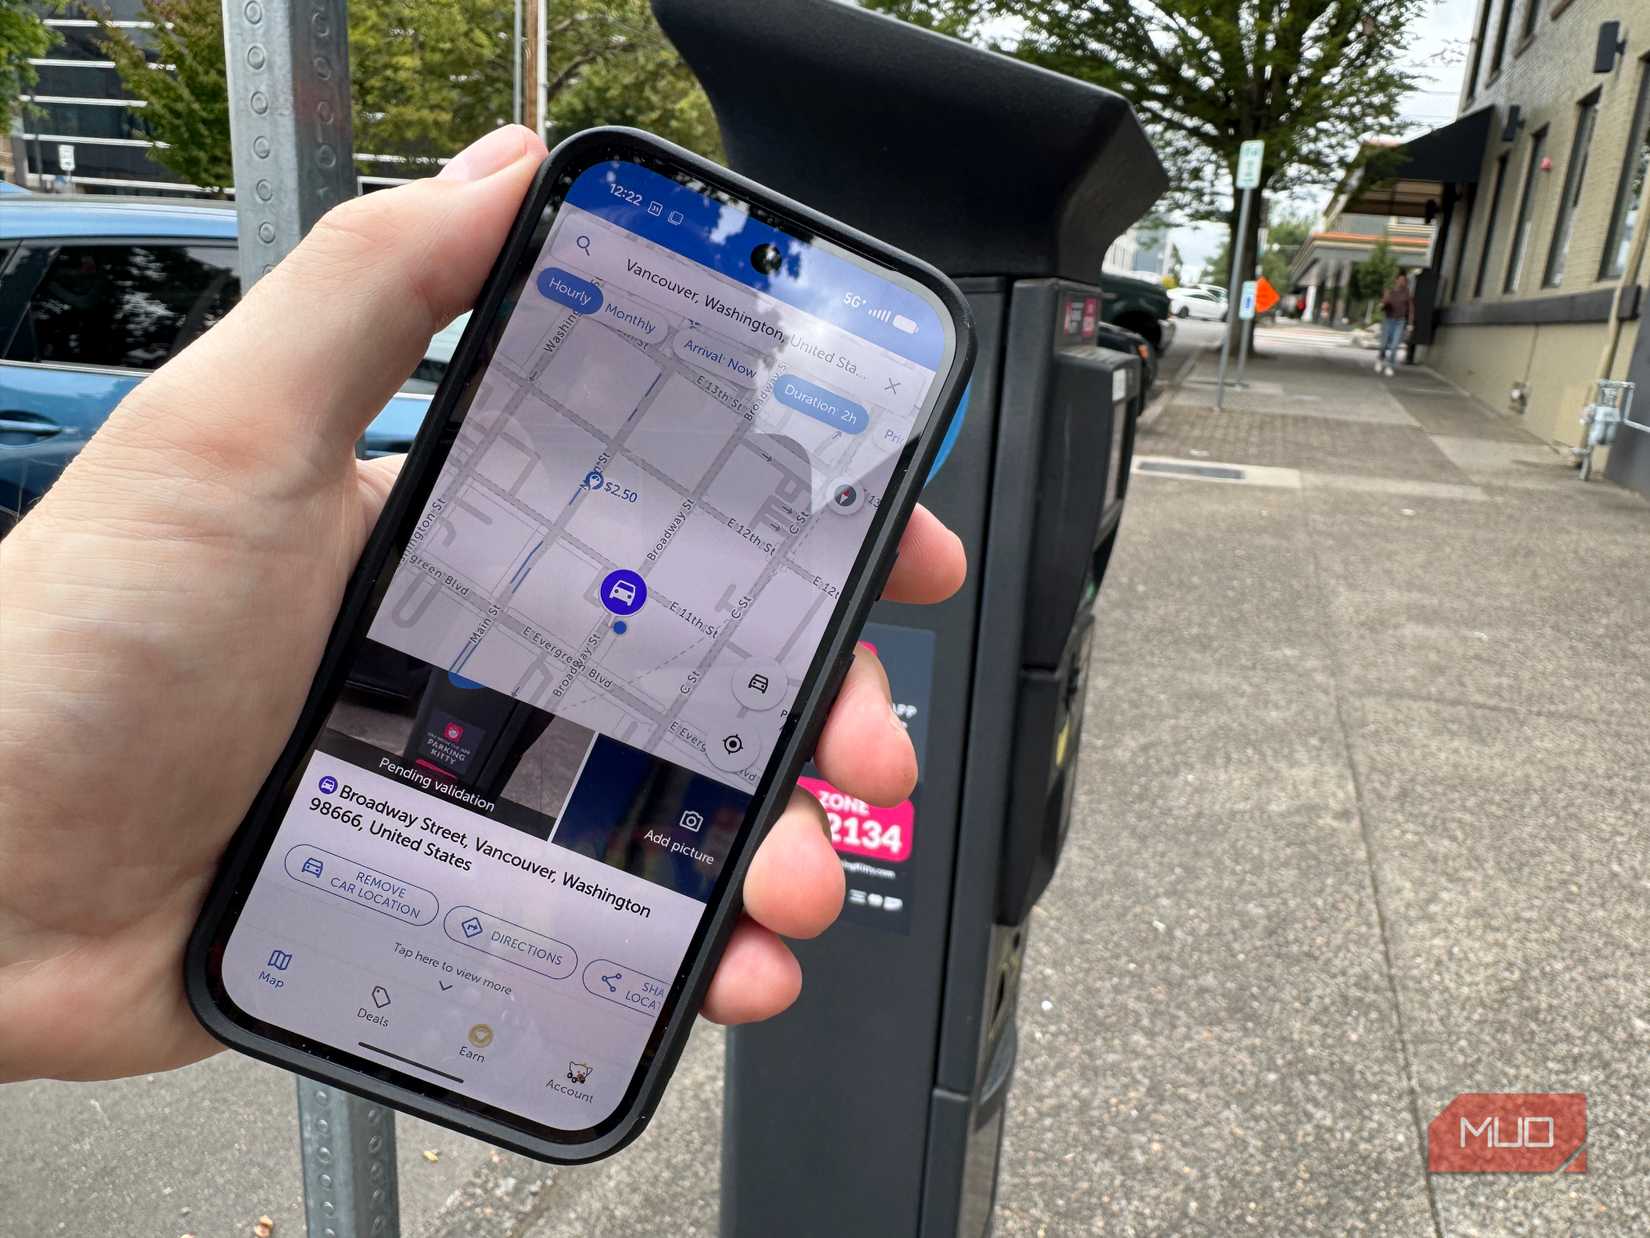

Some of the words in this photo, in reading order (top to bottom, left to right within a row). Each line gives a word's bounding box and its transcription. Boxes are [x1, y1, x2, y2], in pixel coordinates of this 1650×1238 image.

[609, 183, 643, 206] 12:22
[549, 277, 592, 306] Hourly
[605, 303, 656, 335] Monthly
[626, 259, 700, 304] Vancouver,
[704, 294, 785, 343] Washington,
[790, 333, 835, 363] United
[727, 358, 757, 379] Now
[696, 375, 705, 385] E
[705, 381, 728, 402] 13th
[731, 399, 742, 411] St
[841, 409, 857, 425] 2h
[432, 498, 447, 511] St
[604, 481, 638, 503] $2.50
[647, 511, 686, 561] Broadway
[682, 498, 695, 511] St
[796, 512, 809, 524] St
[727, 518, 737, 528] E
[737, 525, 761, 546] 12th
[764, 543, 776, 556] St
[444, 575, 471, 596] Blvd
[812, 576, 821, 587] E
[669, 602, 679, 612] E
[679, 608, 703, 630] 11th
[705, 625, 718, 639] St
[731, 609, 741, 619] C
[738, 596, 752, 609] St
[470, 617, 492, 644] Main
[488, 604, 501, 616] St
[588, 633, 601, 646] St
[522, 626, 532, 636] E
[532, 633, 586, 673] Evergreen
[588, 669, 613, 689] Blvd
[680, 684, 691, 695] C
[687, 671, 700, 684] St
[670, 721, 679, 731] E
[427, 738, 466, 761] PARKING
[431, 748, 457, 765] KITTY
[379, 757, 432, 789] Pending
[435, 780, 495, 812] validation
[818, 789, 870, 817] ZONE
[309, 797, 364, 832] 98666,
[369, 819, 423, 852] United
[424, 842, 473, 871] States
[827, 811, 903, 854] 2134
[339, 784, 418, 828] Broadway
[421, 817, 469, 849] Street,
[475, 837, 557, 883] Vancouver,
[562, 871, 652, 918] Washington
[643, 829, 669, 848] Add
[671, 838, 715, 865] picture
[330, 877, 355, 895] CAR
[357, 888, 421, 919] LOCATION
[356, 871, 407, 899] REMOVE
[491, 930, 564, 966] DIRECTIONS
[258, 971, 285, 989] Map
[393, 942, 413, 958] Tap
[414, 950, 440, 968] here
[441, 961, 454, 973] to
[456, 968, 482, 983] view
[482, 979, 512, 995] more
[357, 1007, 390, 1028] Deals
[459, 1046, 486, 1064] Earn
[545, 1078, 593, 1104] Account
